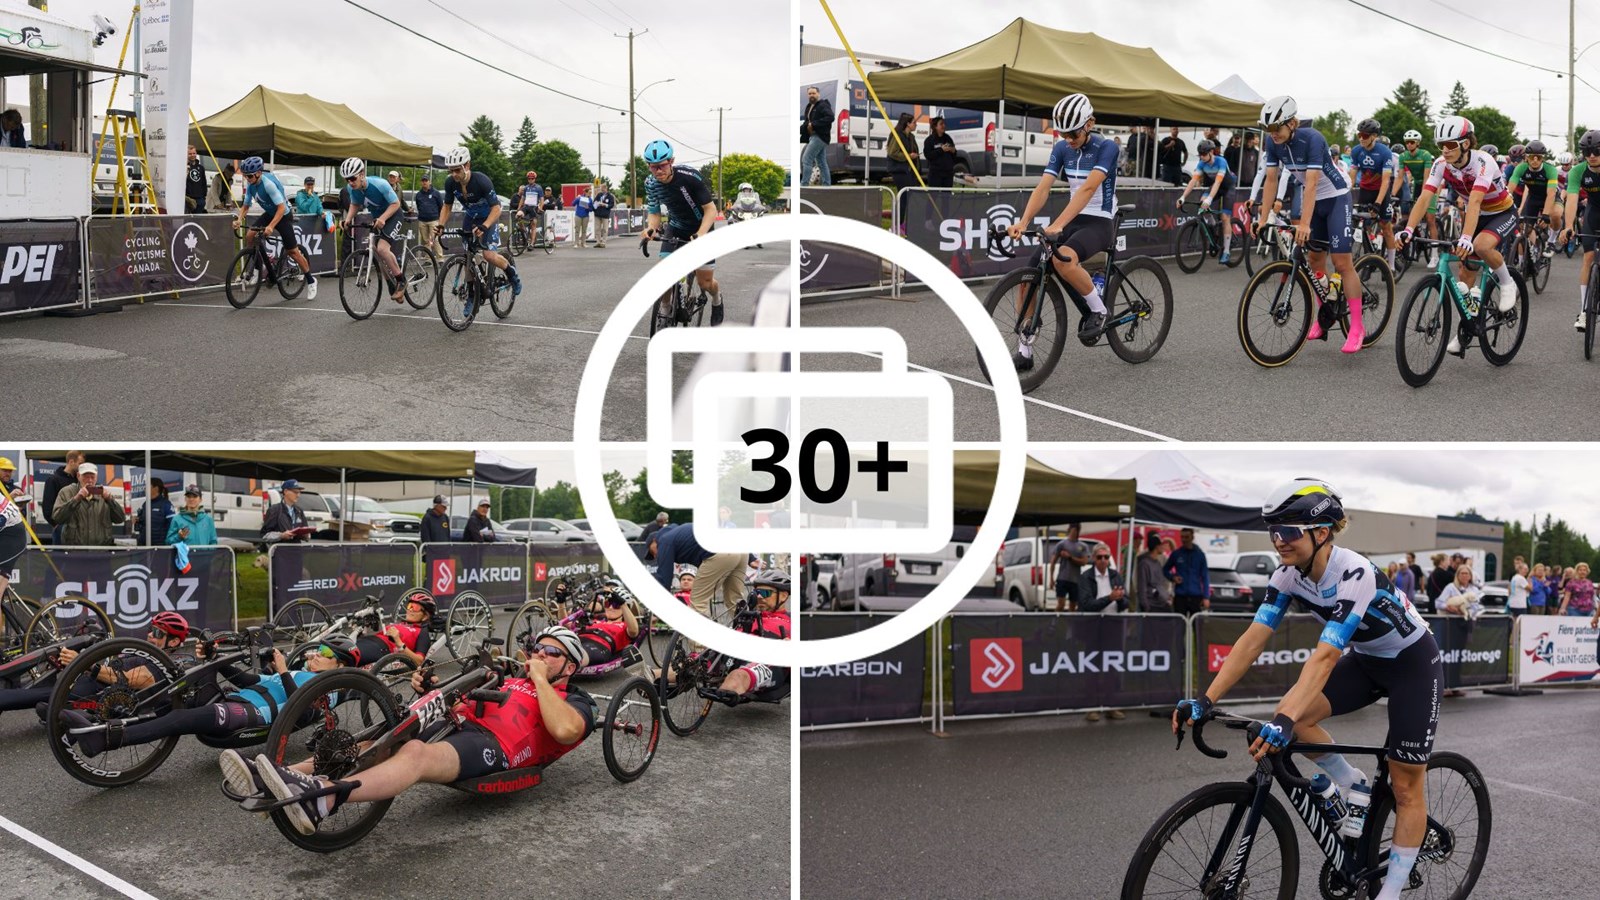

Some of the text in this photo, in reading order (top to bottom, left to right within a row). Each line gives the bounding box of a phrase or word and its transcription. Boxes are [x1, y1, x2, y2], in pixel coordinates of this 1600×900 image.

[1137, 218, 1158, 228] RED
[125, 237, 160, 249] CYCLING
[126, 249, 166, 261] CYCLISME
[127, 262, 160, 274] CANADA
[1313, 499, 1329, 515] ABUS
[457, 566, 521, 584] JAKROO
[548, 564, 587, 577] ARGON
[313, 578, 338, 590] RED
[362, 575, 406, 587] CARBON
[55, 577, 199, 618] SHOKZ
[1029, 650, 1170, 674] JAKROO
[1461, 649, 1502, 664] Storage
[1429, 678, 1438, 723] Telefónica
[1401, 740, 1421, 748] GOBIK
[478, 773, 541, 794] carbonbike
[1289, 786, 1345, 872] CANYON
[1224, 834, 1252, 891] CANYON
